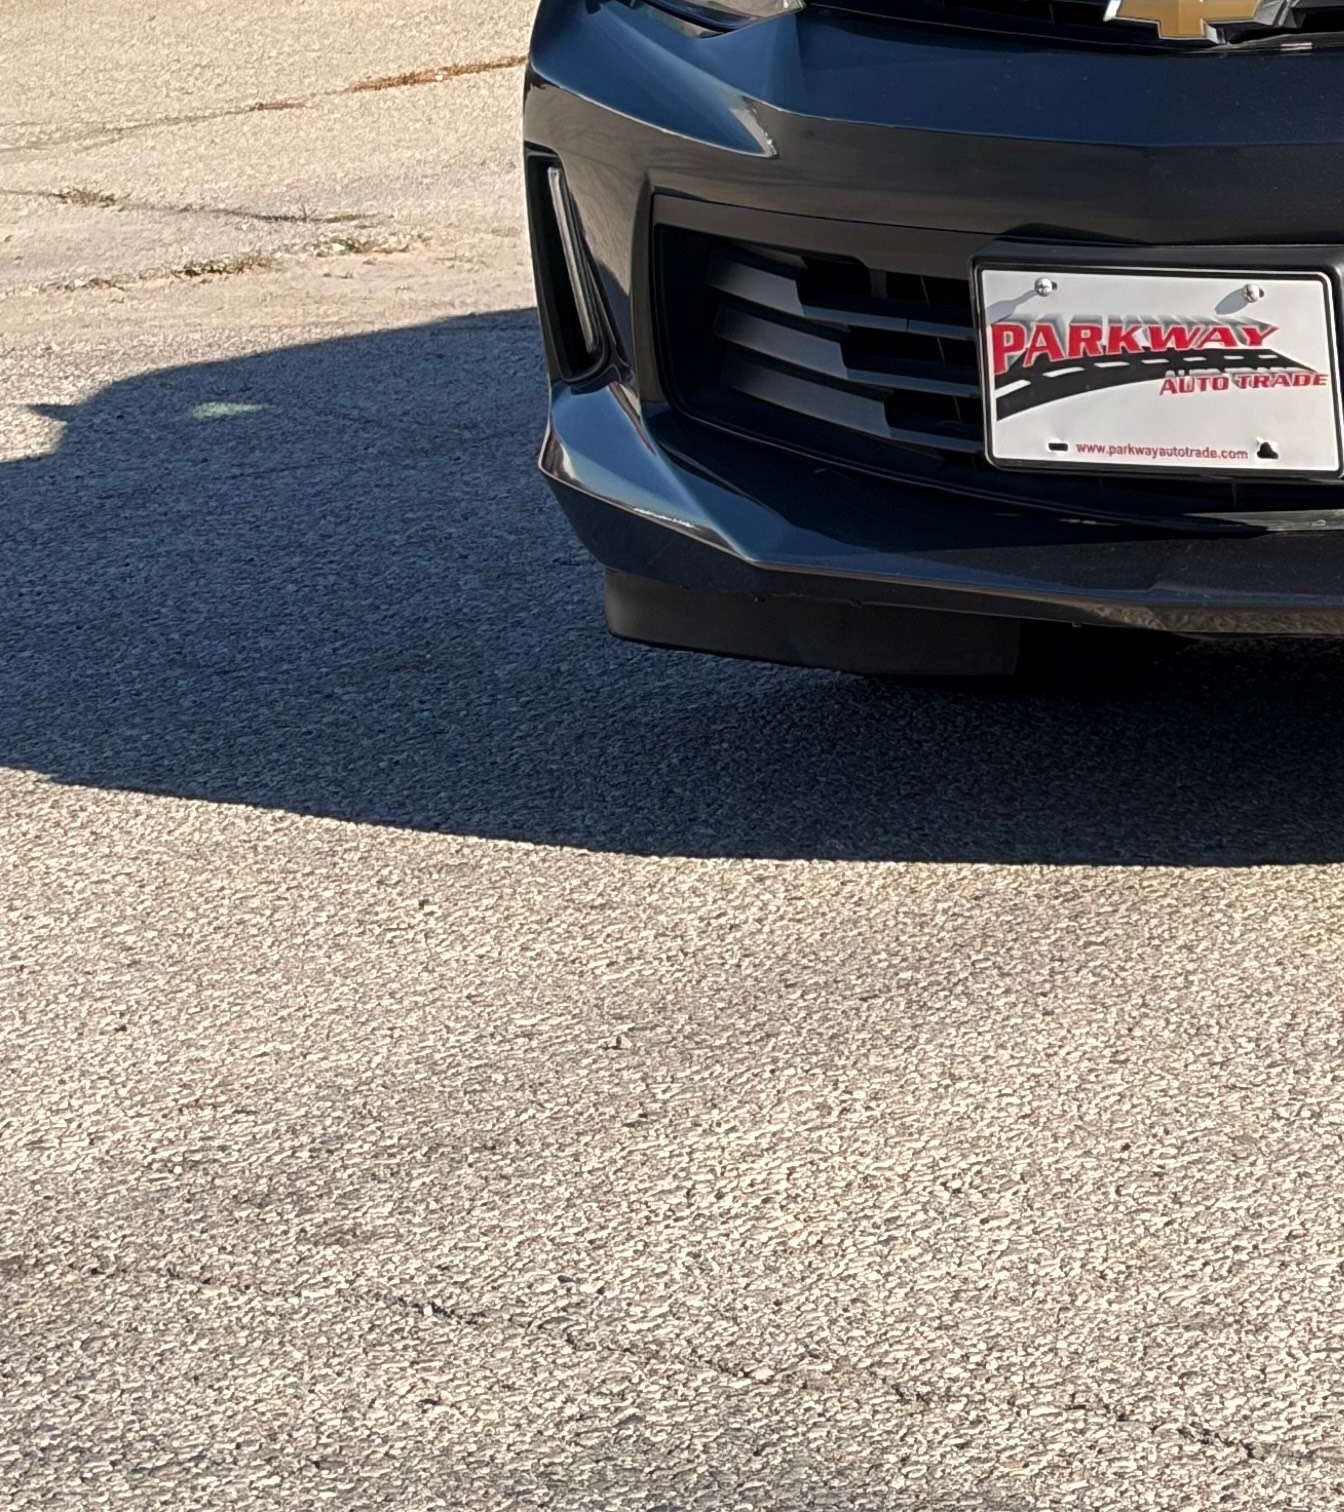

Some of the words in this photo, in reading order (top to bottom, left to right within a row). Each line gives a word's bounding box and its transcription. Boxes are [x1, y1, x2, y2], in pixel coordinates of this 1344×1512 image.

[991, 322, 1279, 375] PARKWAY
[1159, 373, 1229, 396] AUTO
[1235, 372, 1329, 390] TRADE
[1075, 441, 1249, 460] www.parkwayautotrade.com
